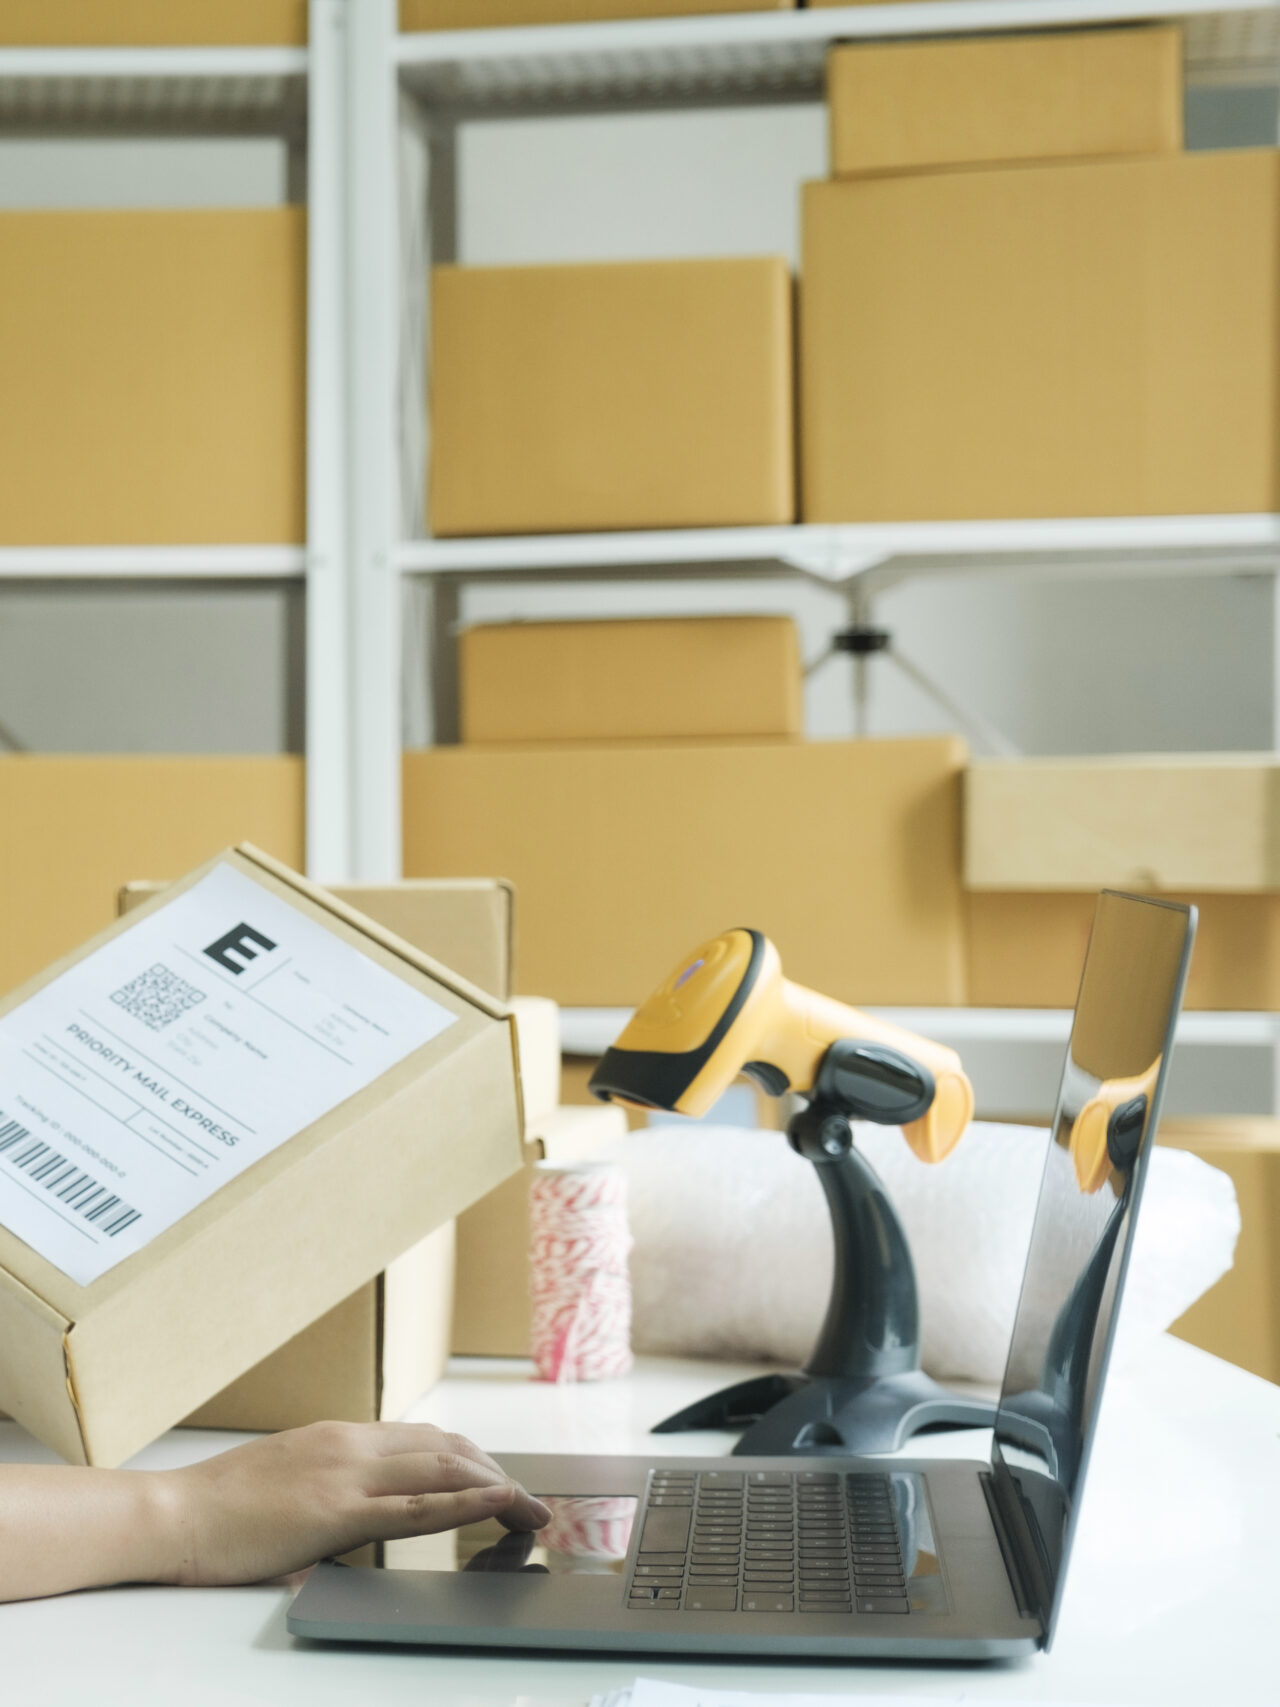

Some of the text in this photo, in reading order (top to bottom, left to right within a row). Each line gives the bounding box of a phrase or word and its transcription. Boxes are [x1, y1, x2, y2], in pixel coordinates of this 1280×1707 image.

[202, 922, 279, 975] E
[66, 1023, 135, 1072] PRIORITY
[132, 1071, 170, 1101] MAIL
[170, 1098, 240, 1147] EXPRESS
